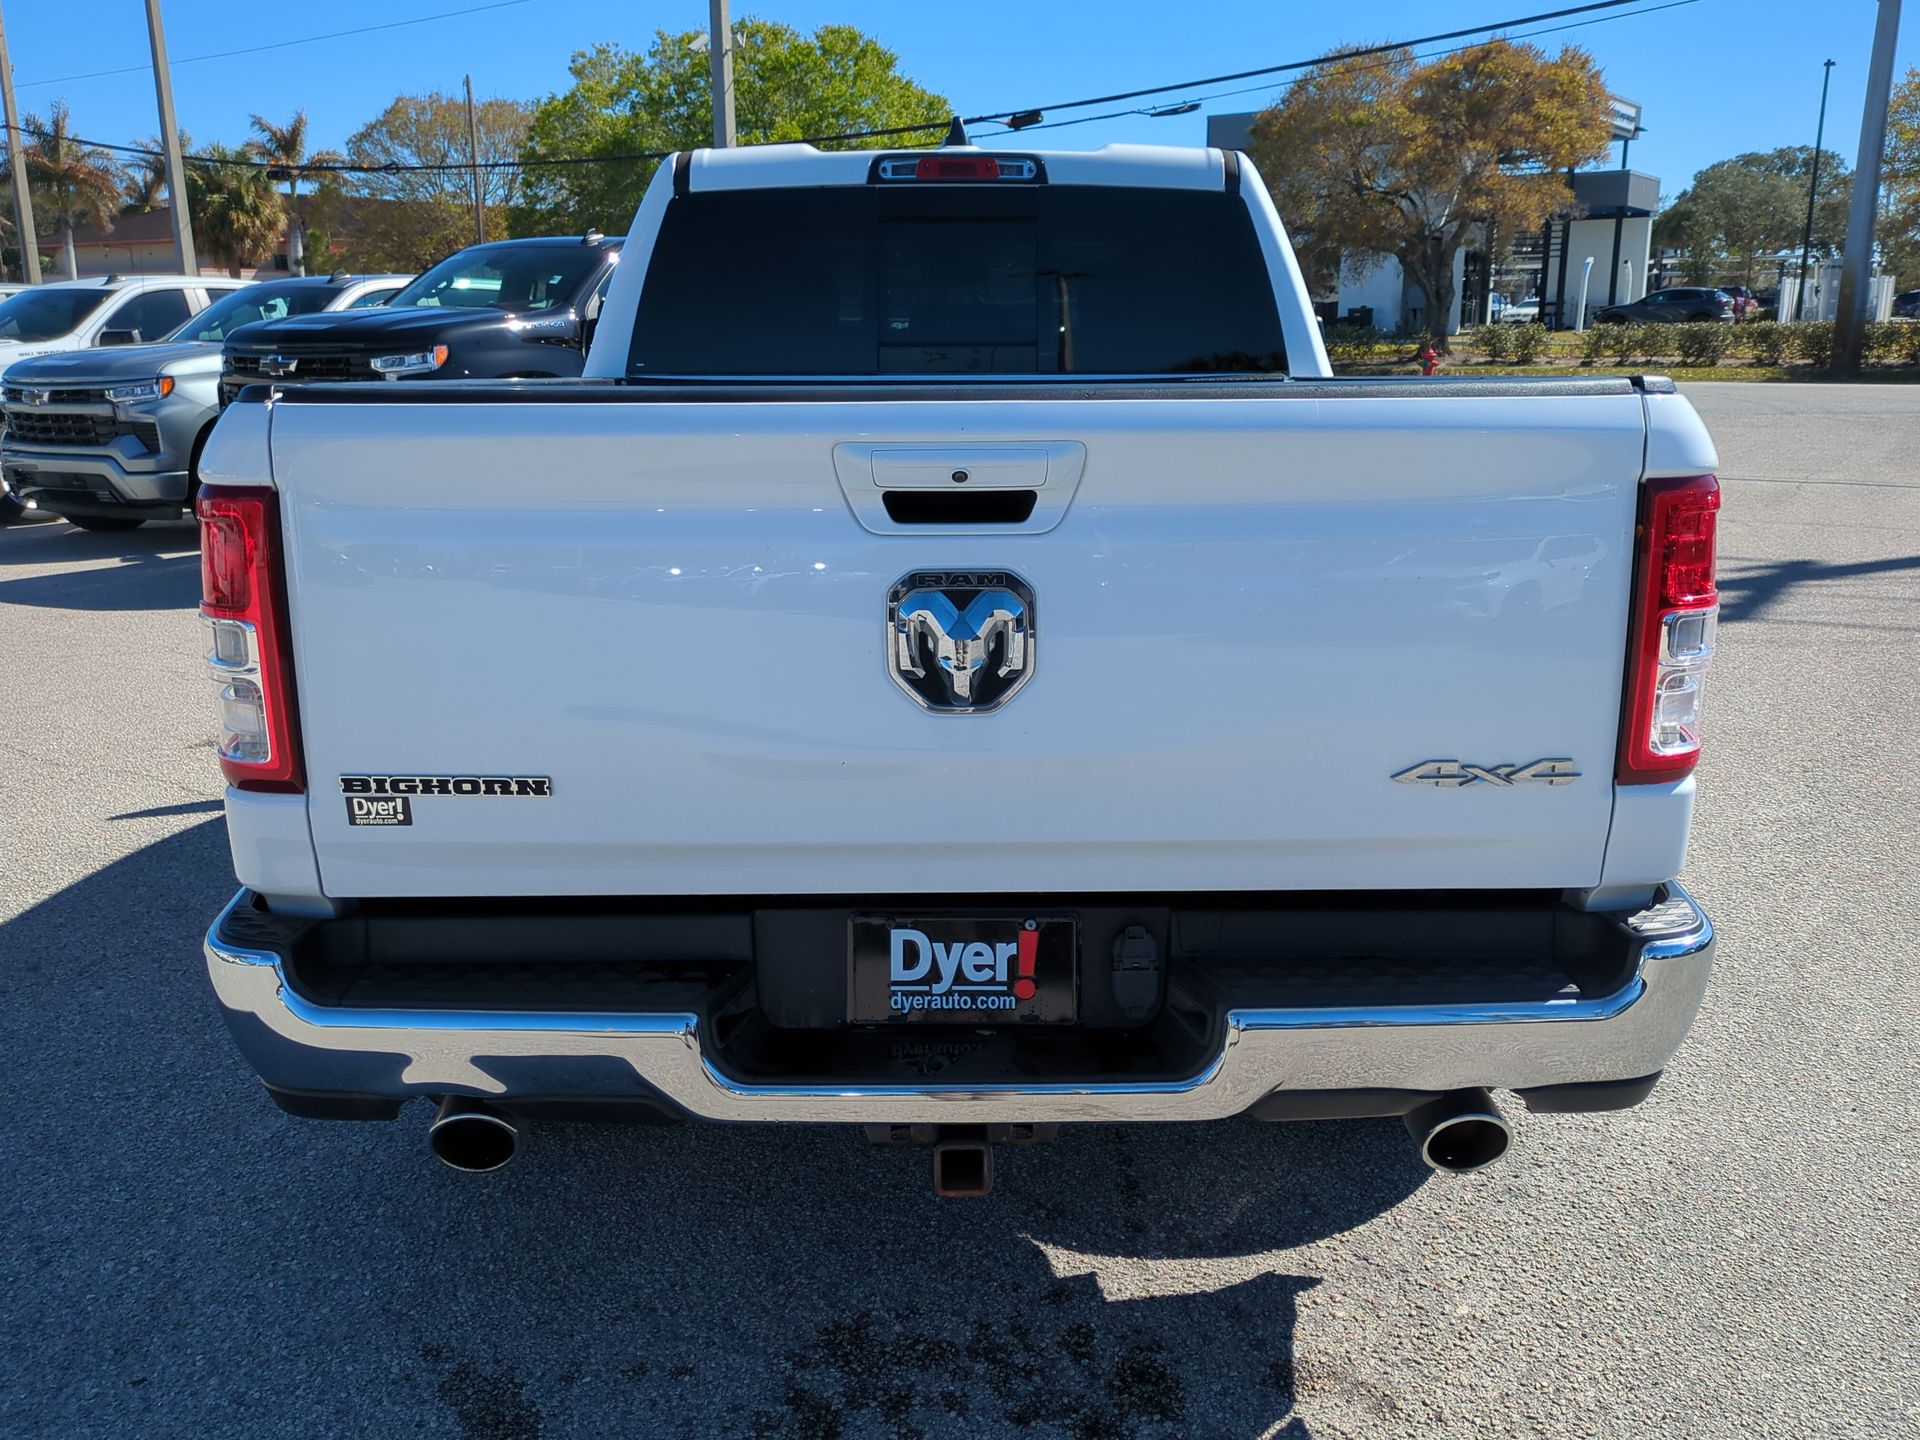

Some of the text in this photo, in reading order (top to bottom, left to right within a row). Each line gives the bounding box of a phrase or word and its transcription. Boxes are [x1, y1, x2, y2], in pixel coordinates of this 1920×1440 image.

[916, 573, 1006, 587] RAM
[1390, 758, 1582, 787] 4x4
[338, 774, 553, 797] BIGHORN
[352, 798, 405, 821] Dyer!
[356, 818, 399, 826] dyerauto.com
[890, 928, 1040, 1000] Dyer!
[890, 992, 1016, 1014] dyerauto.com
